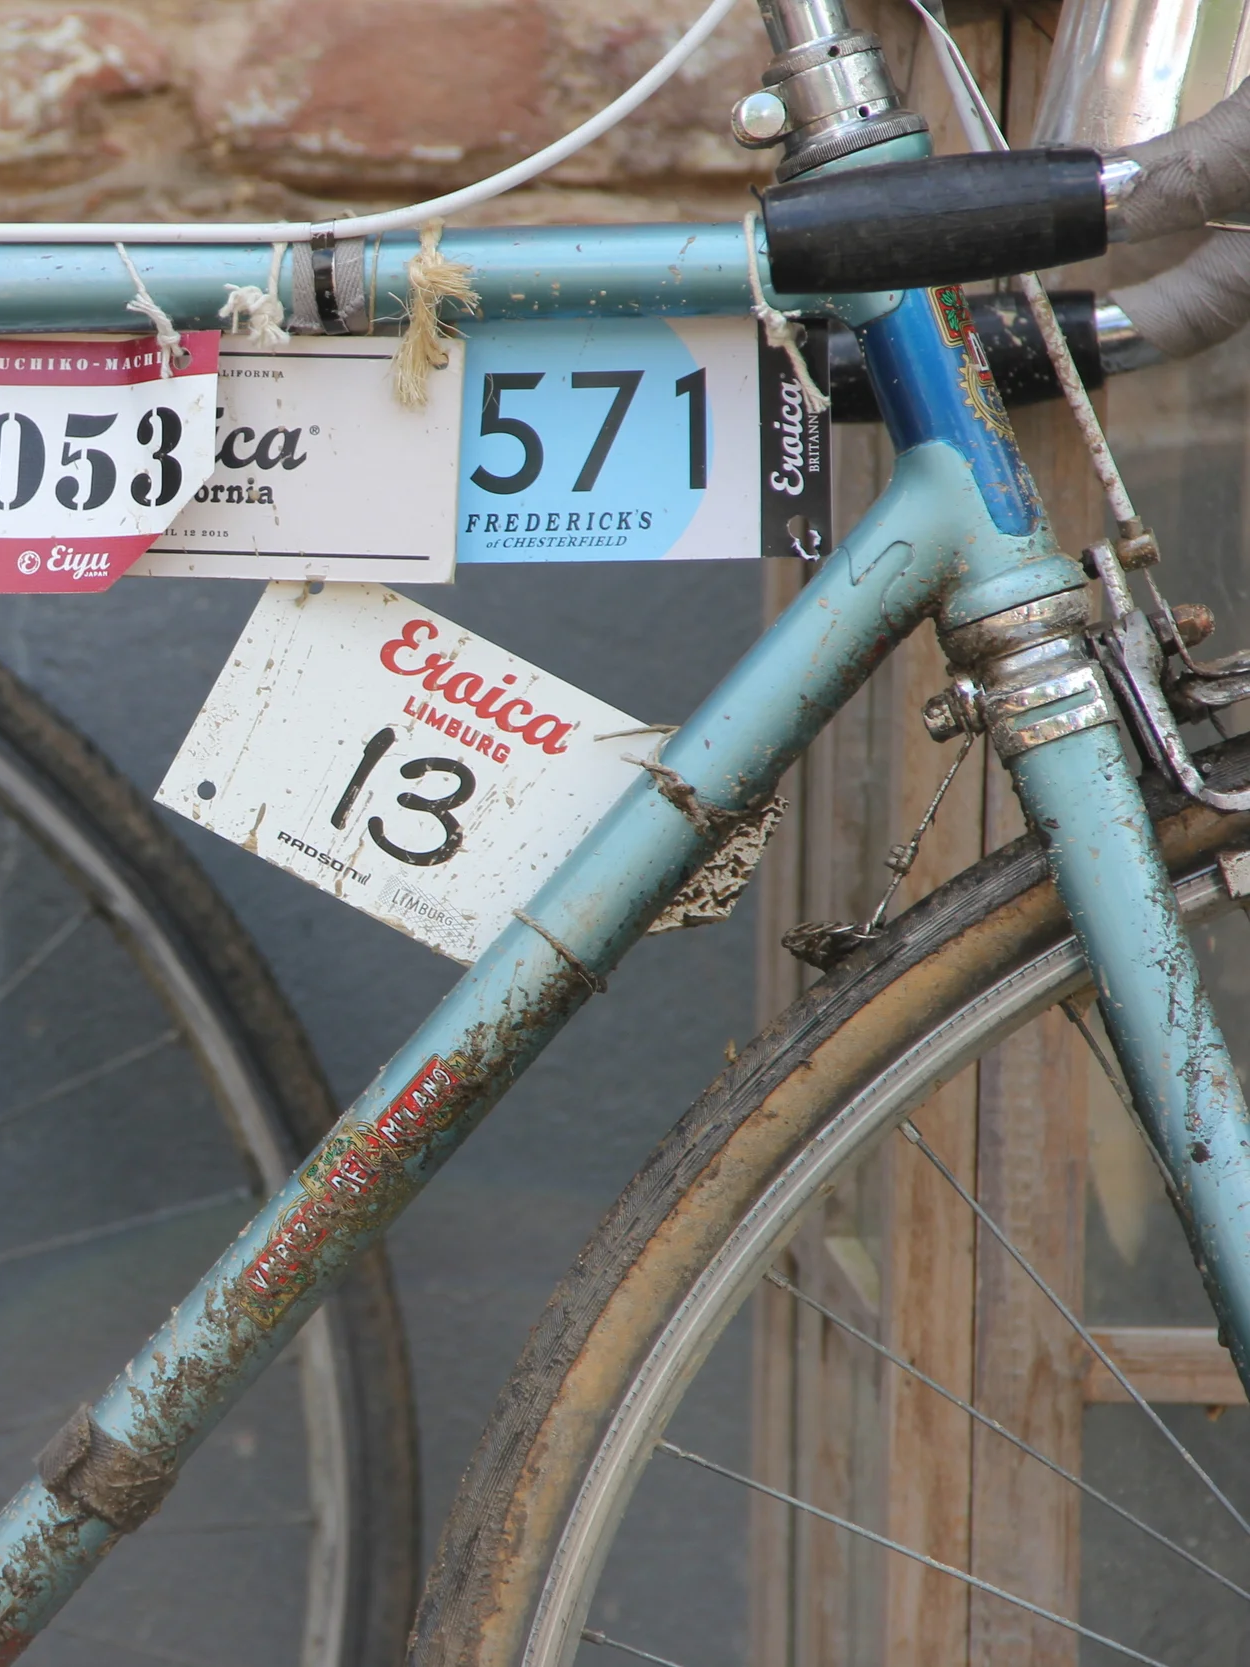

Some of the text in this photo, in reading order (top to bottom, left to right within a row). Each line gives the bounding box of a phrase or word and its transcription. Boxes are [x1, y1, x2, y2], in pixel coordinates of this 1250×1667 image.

[470, 366, 707, 495] 571
[770, 377, 805, 496] Eroica
[807, 411, 820, 472] BRITANN
[183, 529, 197, 537] 12
[201, 530, 229, 538] 2015
[465, 509, 653, 533] FREDERICK'S
[486, 535, 628, 549] of CHESTERFIELD
[47, 544, 111, 580] Eiyu
[380, 618, 574, 756] Eroica
[402, 695, 512, 765] LIMBURG
[330, 727, 477, 867] 13
[392, 888, 454, 927] LIMBURG
